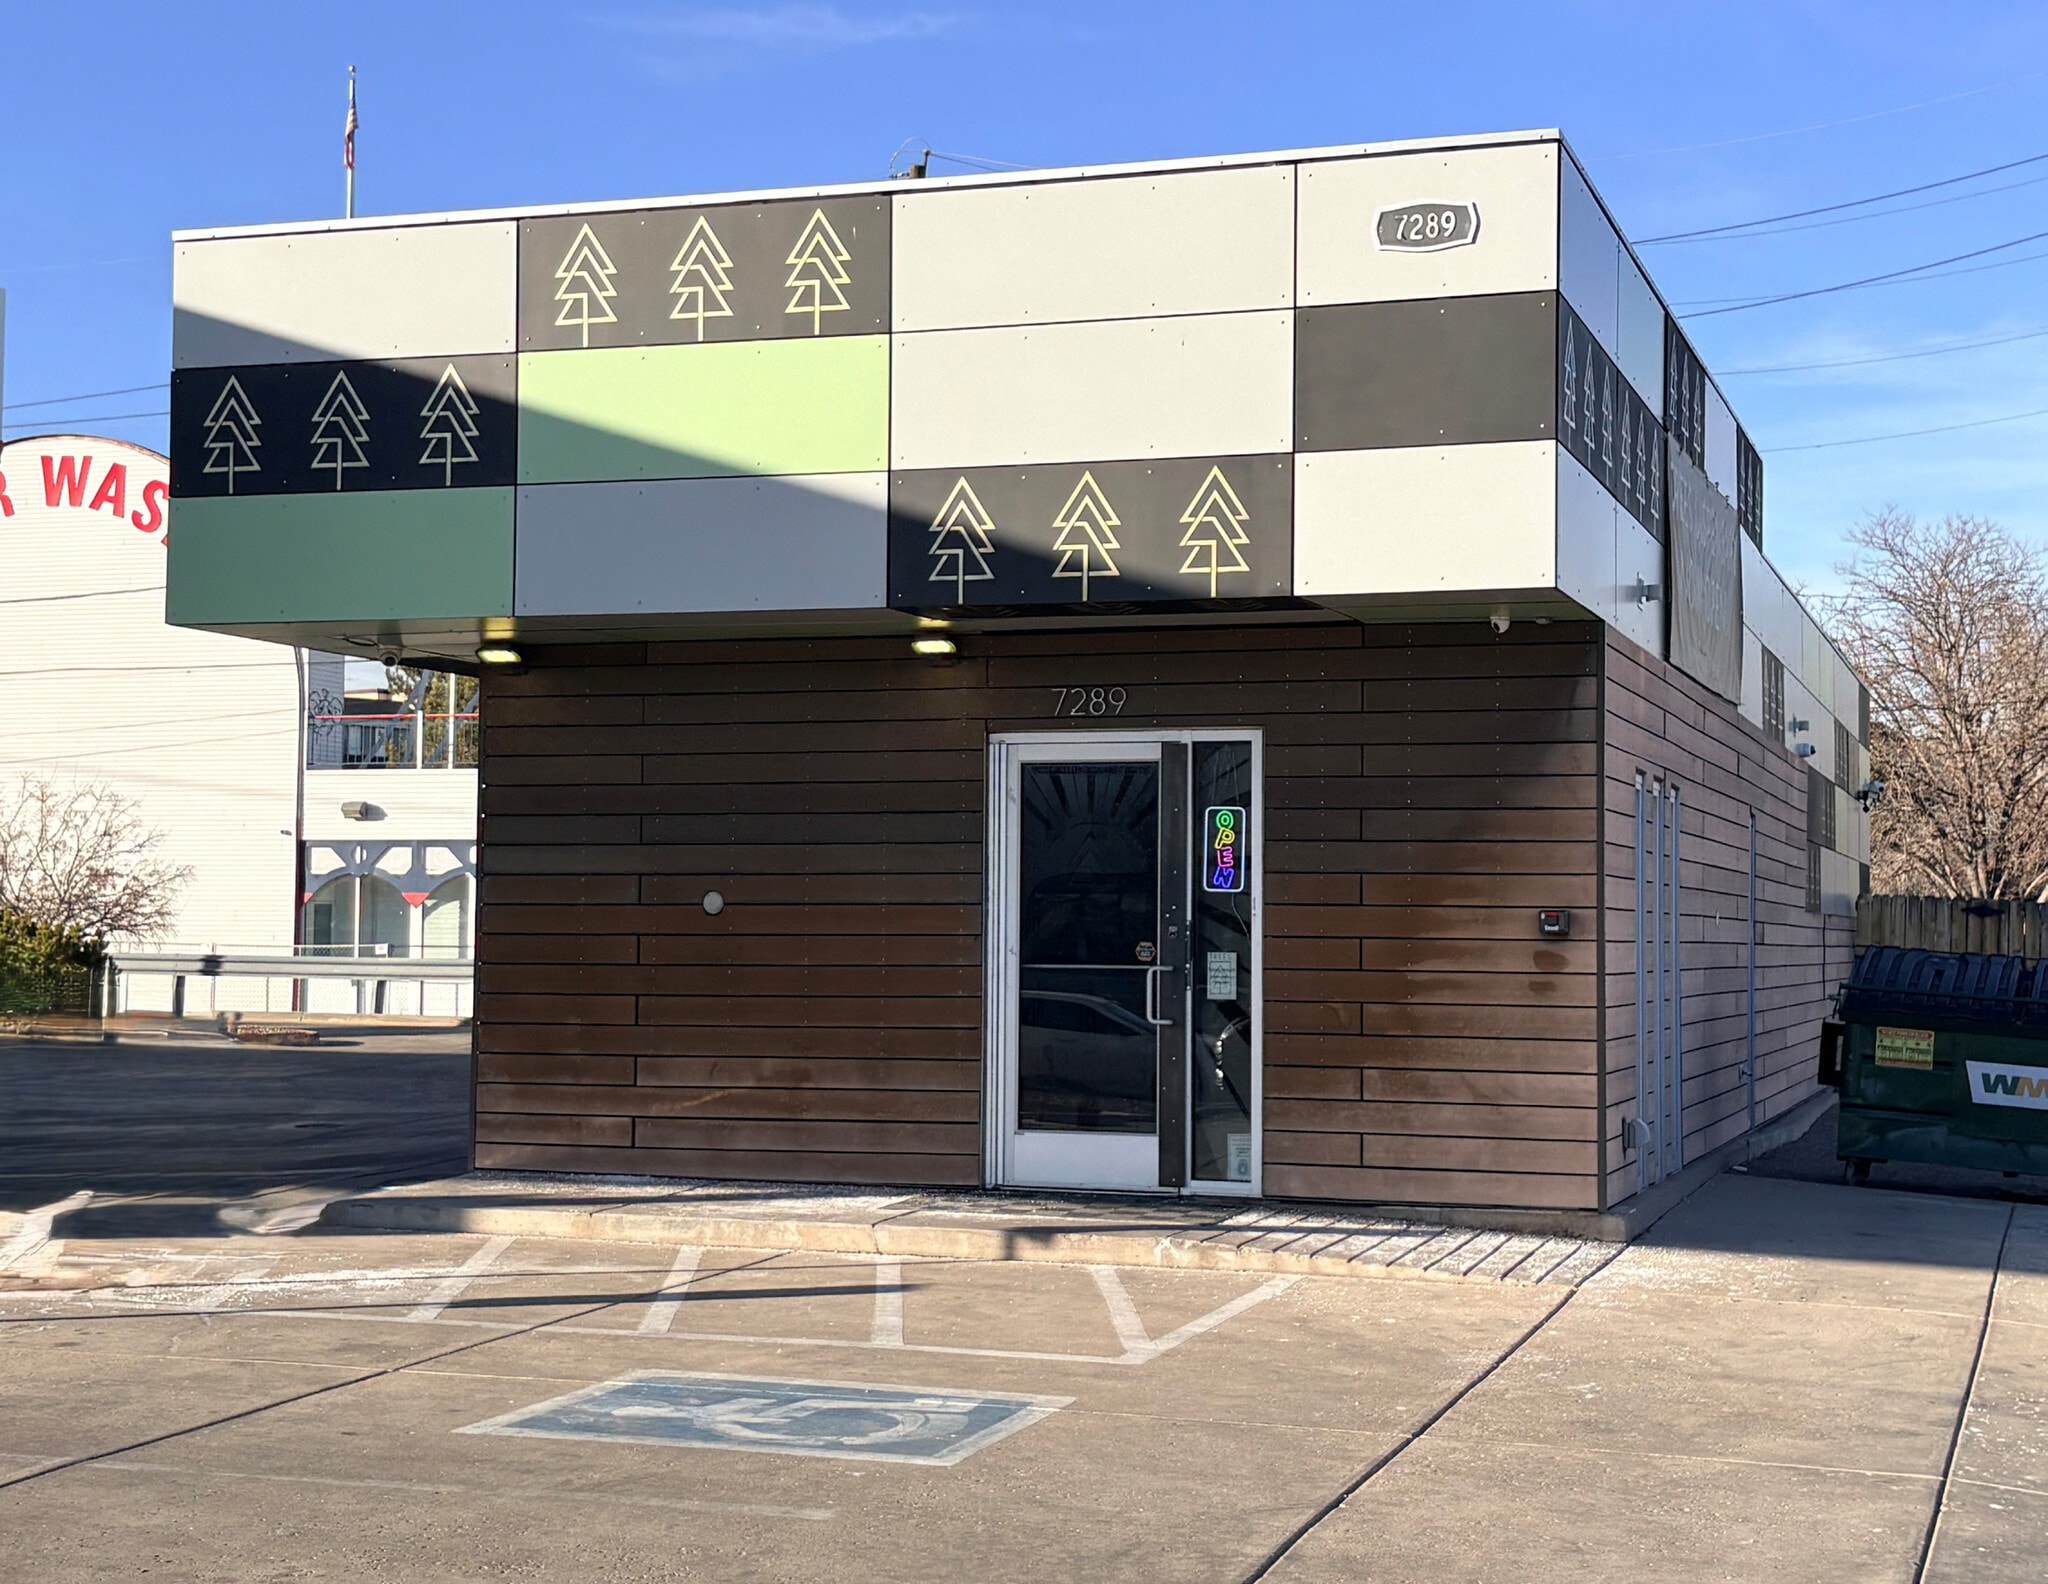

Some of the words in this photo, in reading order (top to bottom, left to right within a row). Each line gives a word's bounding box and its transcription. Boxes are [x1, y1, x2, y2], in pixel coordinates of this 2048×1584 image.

[1394, 210, 1457, 240] 7289
[40, 455, 170, 547] WAS
[1051, 687, 1127, 716] 7289
[1213, 810, 1235, 888] OPEN
[1981, 1072, 2048, 1099] WM
